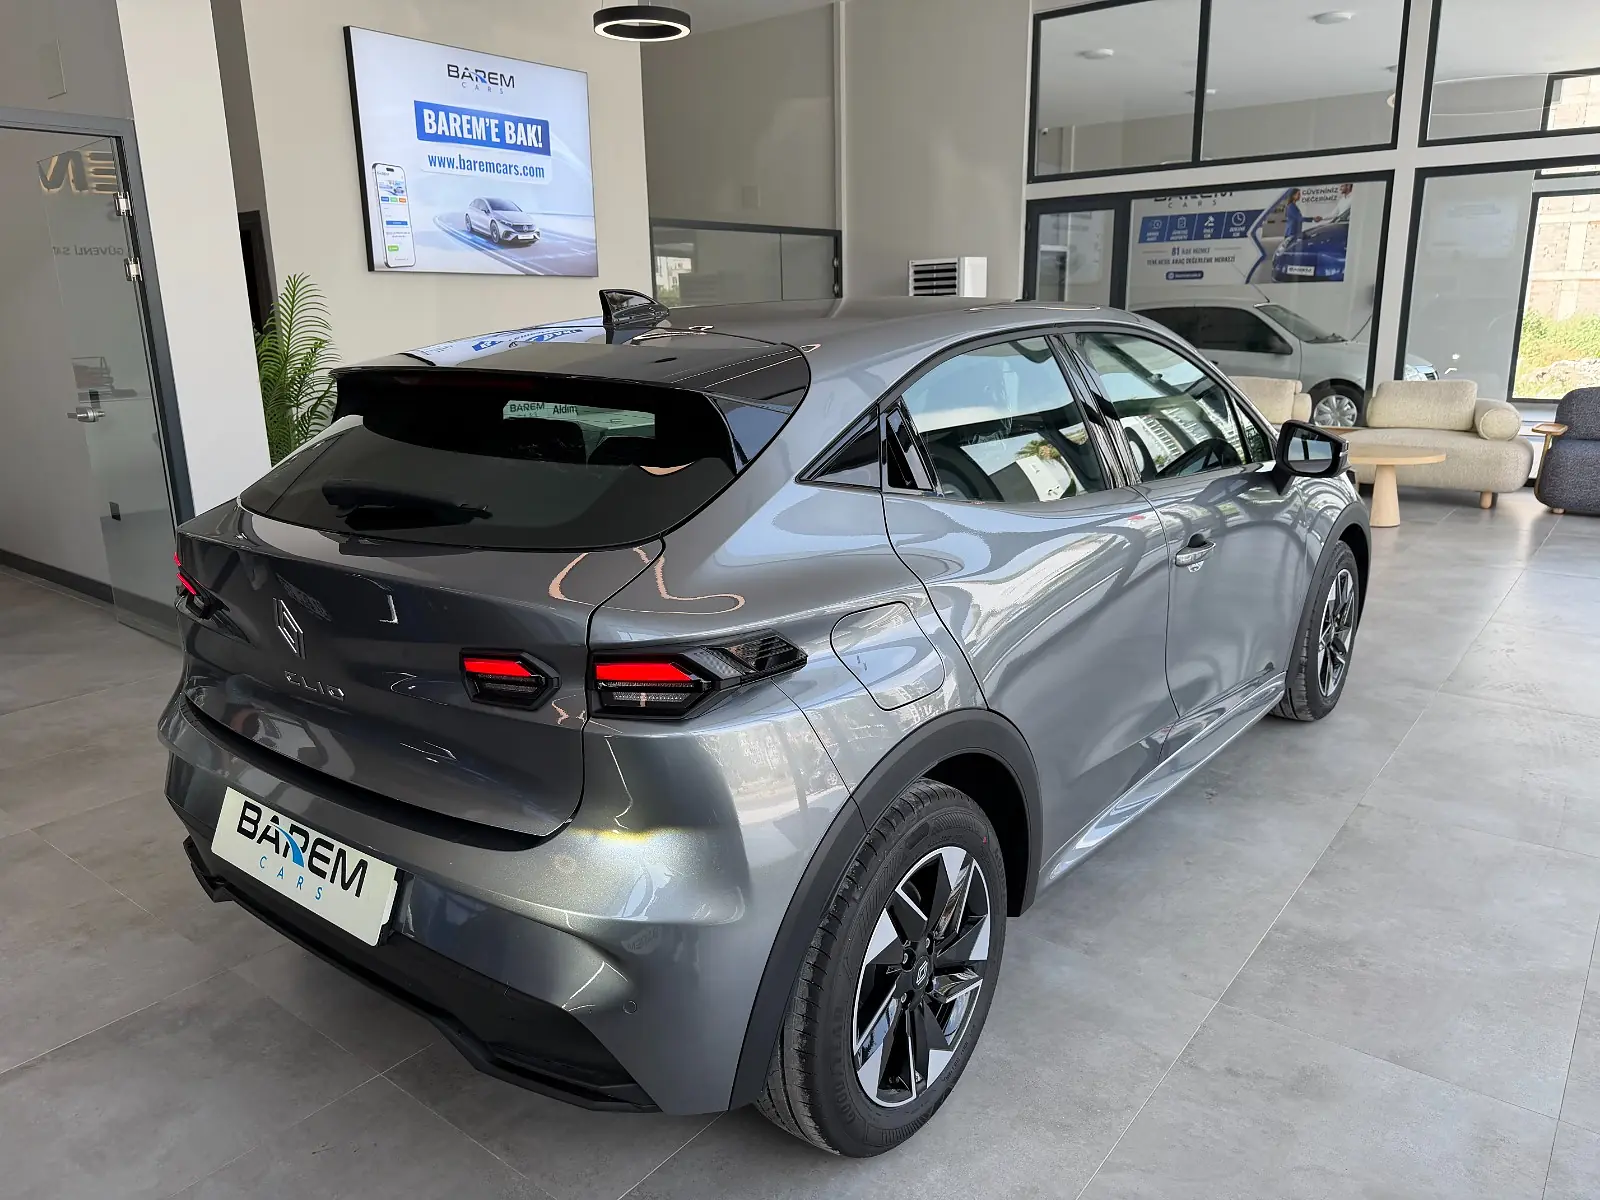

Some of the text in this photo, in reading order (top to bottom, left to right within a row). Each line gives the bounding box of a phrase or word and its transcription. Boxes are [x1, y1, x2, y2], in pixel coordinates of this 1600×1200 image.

[447, 63, 515, 88] BAREM
[461, 81, 504, 95] CARS
[423, 108, 543, 148] BAREM'E BAK!
[427, 153, 545, 179] www.baremcars.com
[1168, 200, 1217, 209] CARS
[1171, 247, 1180, 256] 81
[509, 402, 545, 413] BAREM
[284, 670, 345, 702] CLIO
[236, 800, 369, 898] BAREM
[259, 855, 323, 900] CARS
